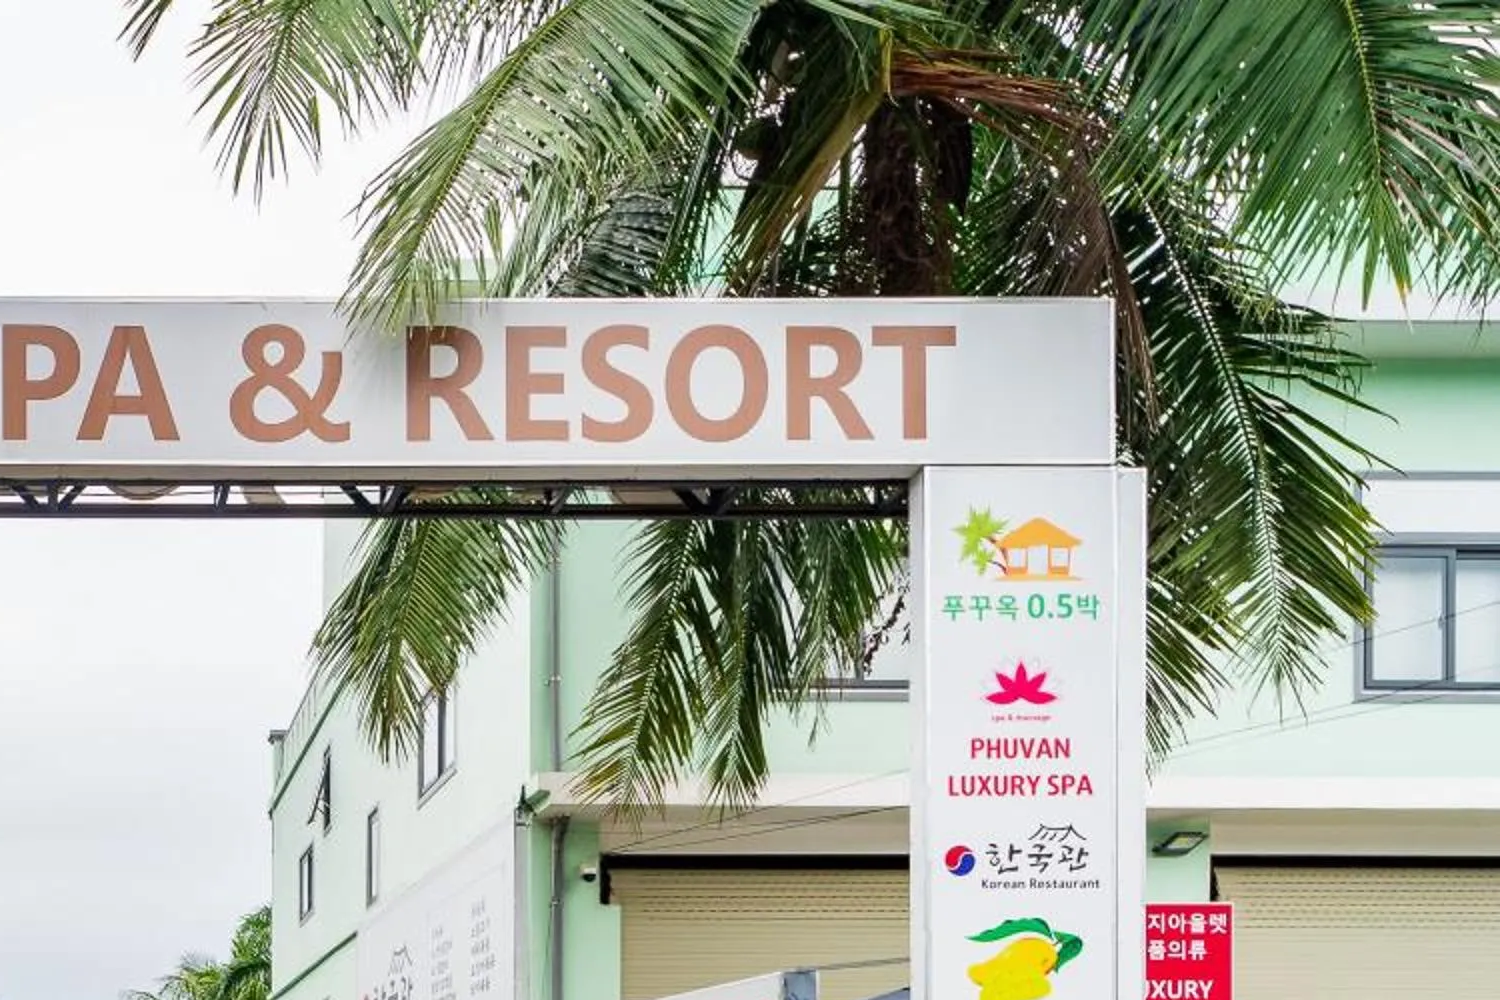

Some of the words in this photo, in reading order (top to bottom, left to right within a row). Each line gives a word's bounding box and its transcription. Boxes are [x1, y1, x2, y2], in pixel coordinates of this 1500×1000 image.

[229, 323, 351, 443] &
[405, 323, 957, 443] RESORT
[941, 595, 1019, 621] 푸꾸옥
[1027, 593, 1100, 621] 0.5박
[970, 737, 1071, 759] PHUVAN
[948, 775, 1041, 796] LUXURY
[1047, 775, 1093, 796] SPA
[985, 843, 1089, 874] 한국관
[981, 878, 1025, 889] Korean
[1029, 878, 1100, 889] Restaurant
[1145, 912, 1227, 935] 지아울렛
[1145, 939, 1207, 961] 품의류
[1144, 979, 1213, 1000] XURY
